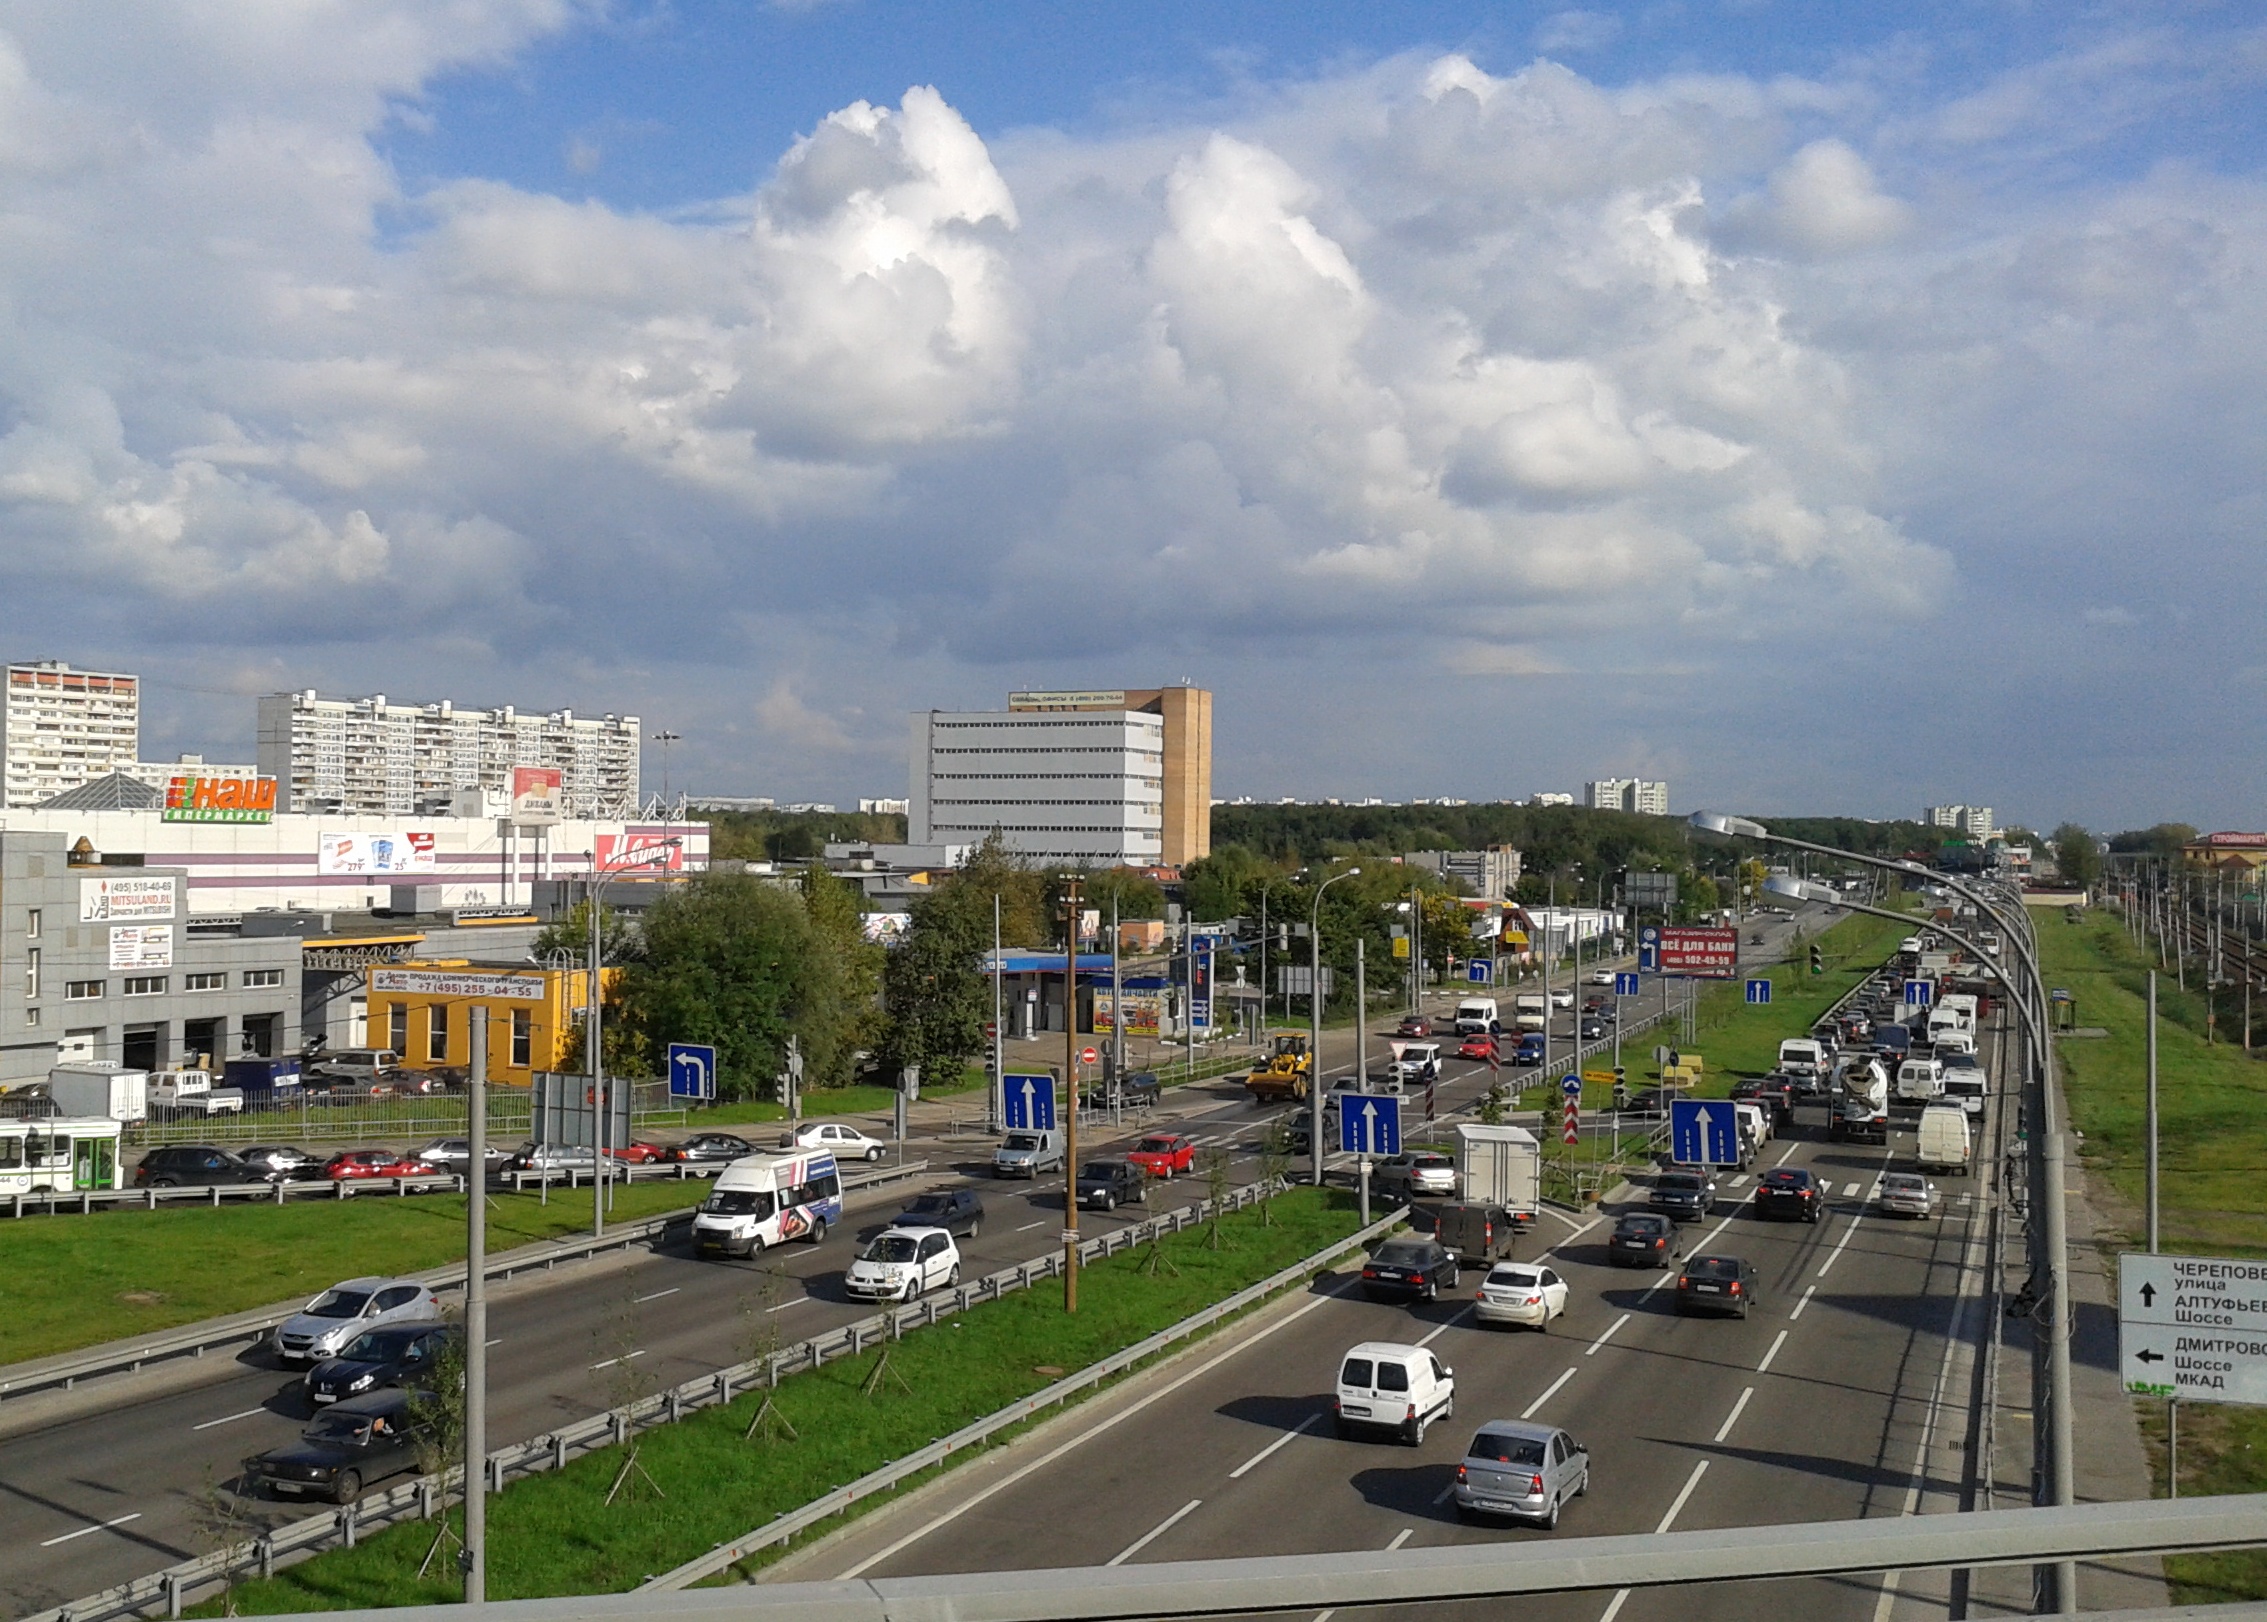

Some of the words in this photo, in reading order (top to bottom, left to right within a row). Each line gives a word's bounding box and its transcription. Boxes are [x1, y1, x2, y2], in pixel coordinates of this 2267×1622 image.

[163, 809, 273, 821] ГИПЕРМАРКЕТ
[111, 882, 132, 894] (495)
[110, 894, 172, 906] MITSULAND.RU
[1660, 938, 1680, 951] ВСЁ
[1682, 941, 1705, 952] ДЛЯ
[1707, 942, 1736, 952] БАНИ
[1685, 955, 1730, 965] 502-49-59
[409, 973, 442, 982] ПРОДАЖА
[417, 982, 431, 991] +7
[433, 983, 462, 995] (495)
[464, 984, 485, 994] 255
[494, 986, 508, 995] 04
[517, 987, 532, 997] 55
[2173, 1262, 2267, 1281] ЧЕРЕПОВЕ
[2174, 1278, 2226, 1292] улица
[2175, 1372, 2225, 1389] МКАД
